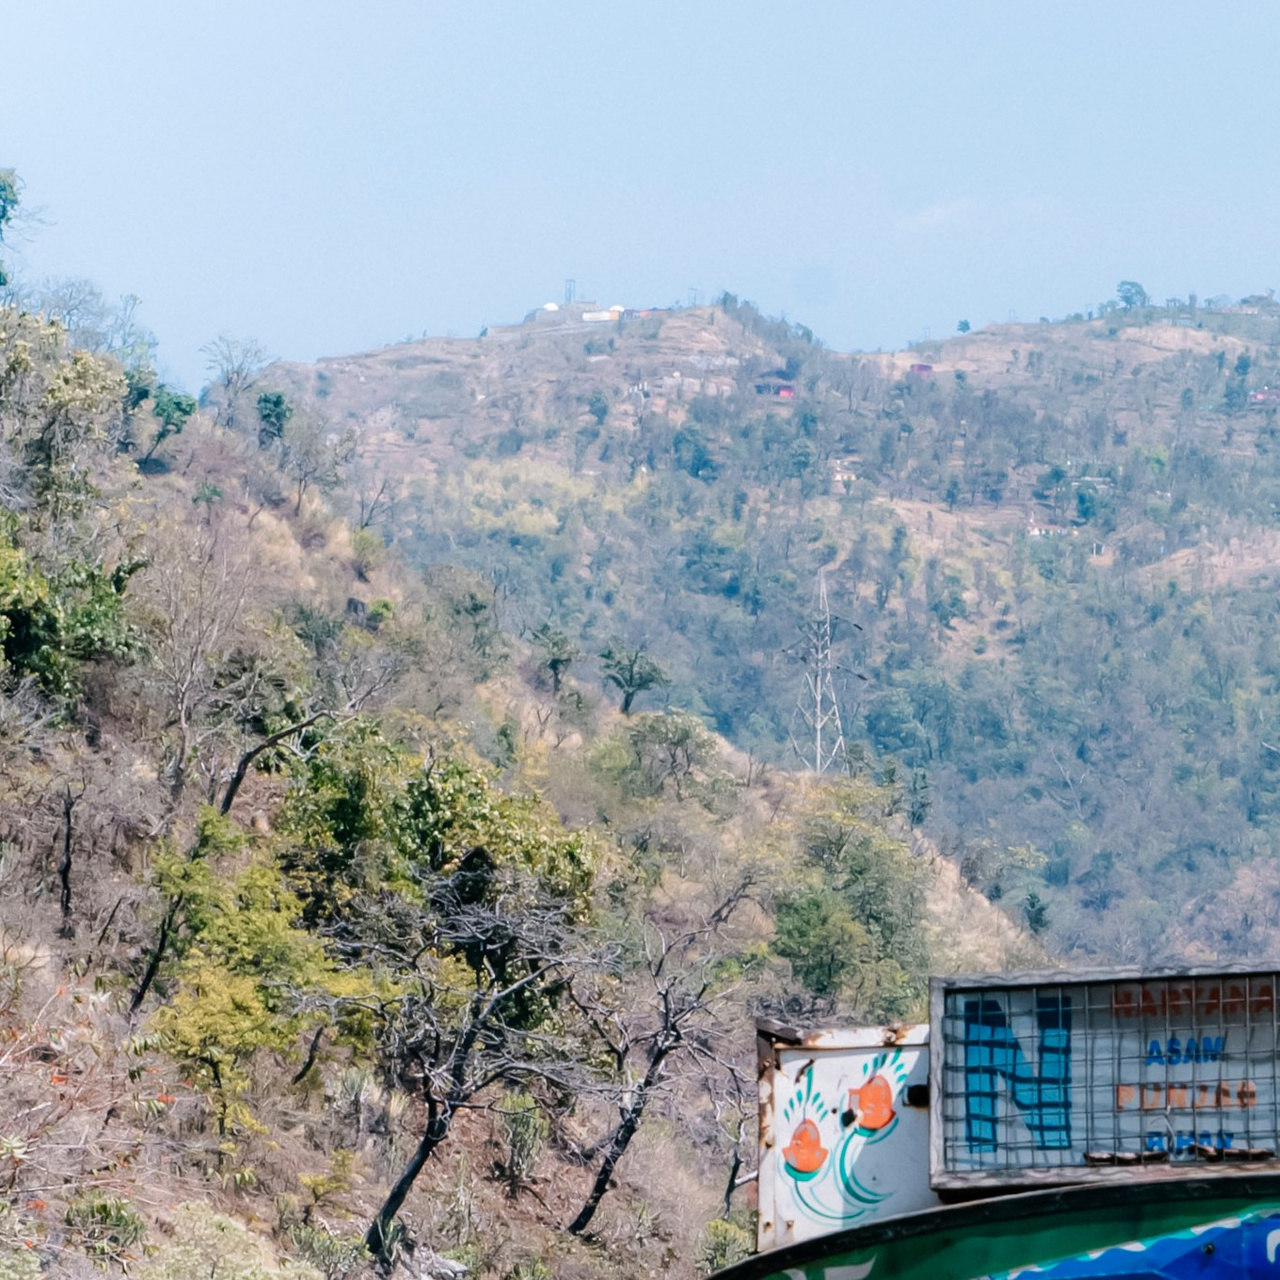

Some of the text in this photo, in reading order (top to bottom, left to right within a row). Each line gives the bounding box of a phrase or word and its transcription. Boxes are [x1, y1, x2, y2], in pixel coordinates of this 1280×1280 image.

[1110, 983, 1274, 1018] HARYANA
[1145, 1036, 1224, 1067] ASAM
[964, 997, 1072, 1153] N
[1115, 1079, 1258, 1113] PUNJAB
